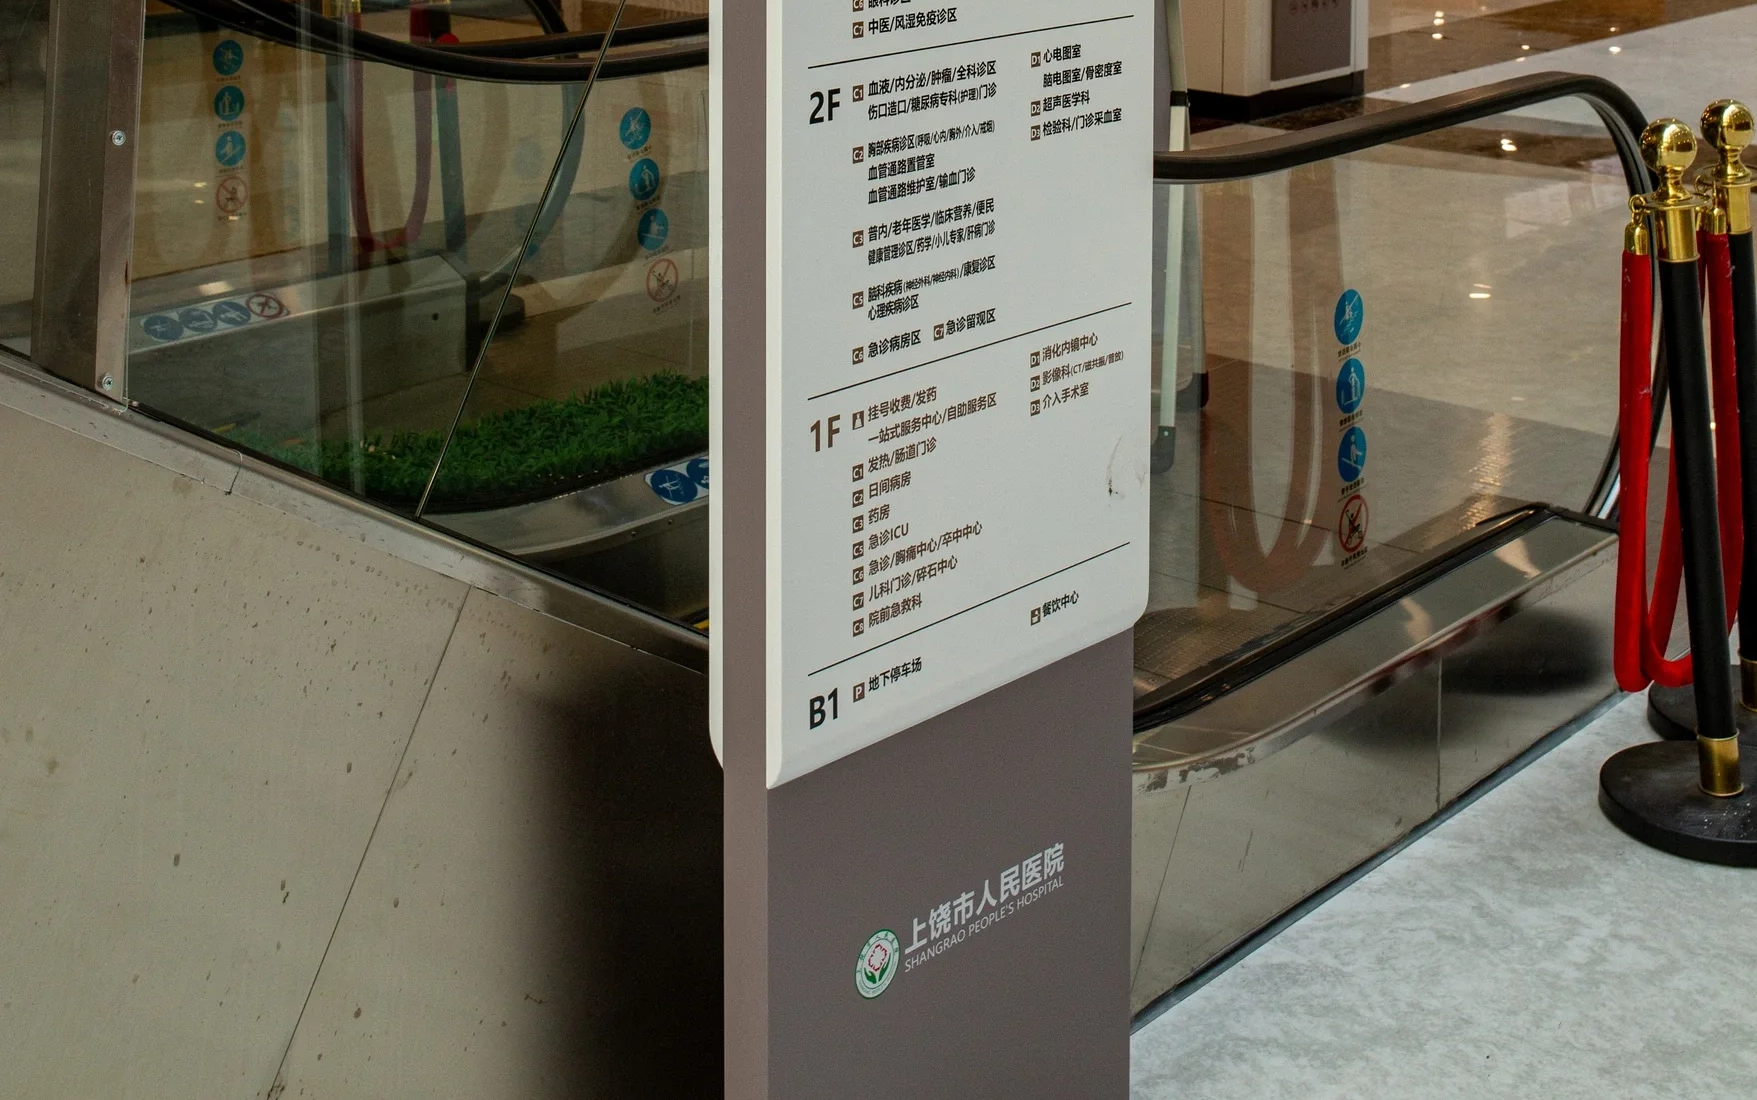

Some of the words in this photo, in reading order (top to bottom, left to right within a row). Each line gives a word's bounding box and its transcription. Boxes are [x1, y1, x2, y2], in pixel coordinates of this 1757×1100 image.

[868, 7, 958, 36] 中医/风湿免疫诊区
[1043, 44, 1081, 63] 心电图室
[868, 60, 996, 96] 血液/内分泌/肿瘤/全科诊区
[1043, 60, 1122, 88] 脑电图室/骨密度室
[809, 88, 840, 125] 2F
[1043, 90, 1090, 112] 超声医学科
[1043, 108, 1122, 136] 检验科/门诊采血室
[868, 153, 935, 181] 血管通路置管室
[868, 166, 976, 204] 血管通路维护室/输血门诊
[868, 198, 994, 242] 普内/老年医学/临床营养/便民
[868, 294, 919, 321] 心理疾病诊区
[868, 330, 921, 359] 急诊病房区
[946, 308, 996, 336] 急诊留观区
[1042, 332, 1098, 362] 消化内镜中心
[868, 386, 937, 422] 挂号收费/发药
[1043, 382, 1089, 409] 介入手术室
[810, 414, 840, 453] 1F
[868, 392, 997, 446] 一站式服务中心/自助服务区
[868, 437, 937, 473] 发热/肠道门诊
[868, 471, 912, 500] 日间病房
[868, 504, 890, 526] 药房
[868, 522, 909, 550] 急诊ICU
[868, 520, 982, 576] 急诊/胸痛中心/卒中中心
[868, 555, 958, 602] 儿科门诊/碎石中心
[869, 593, 922, 628] 院前急救科
[1042, 590, 1079, 618] 餐饮中心
[868, 656, 922, 692] 地下停车场
[810, 688, 838, 730] B1
[904, 842, 1064, 955] 上饶市人民医院
[904, 930, 966, 973] SHANGRAO
[968, 904, 1014, 938] PEOPLE'S
[1016, 876, 1064, 910] HOSPITAL
